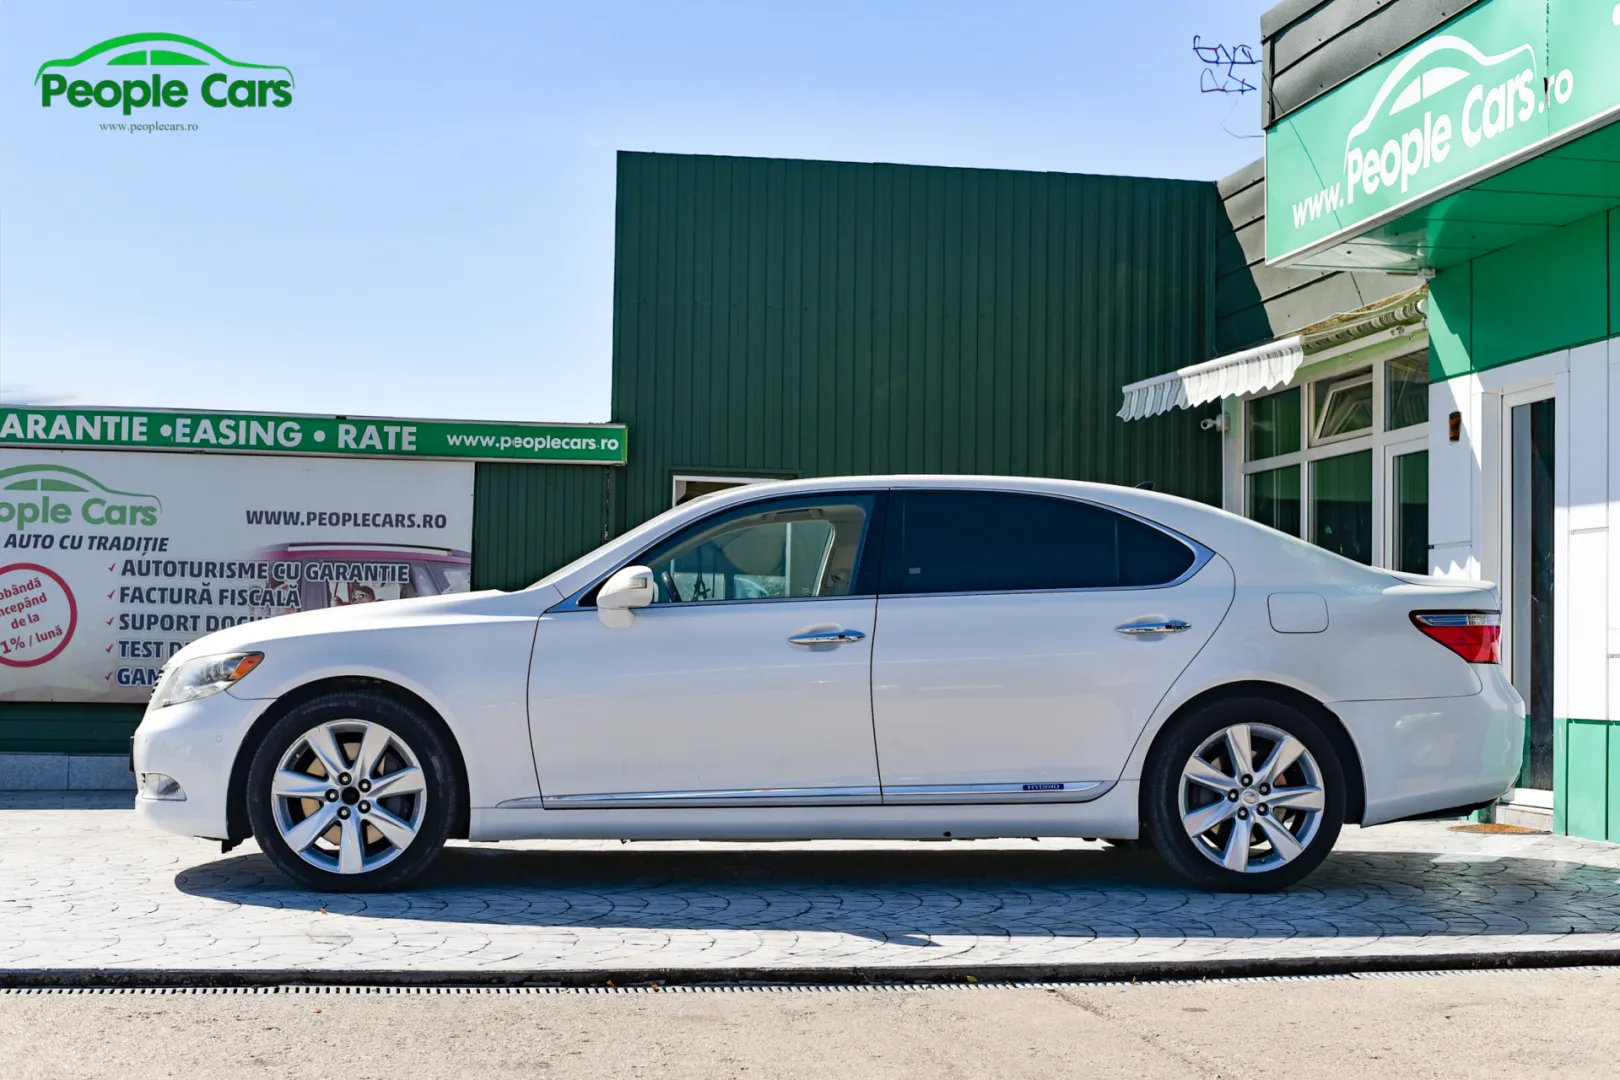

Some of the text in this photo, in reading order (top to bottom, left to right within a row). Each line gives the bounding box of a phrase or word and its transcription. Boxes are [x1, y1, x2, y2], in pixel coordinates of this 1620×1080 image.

[0, 413, 417, 450] ARANTIE EASING RATE
[447, 433, 619, 452] www.peoplecars.ro
[81, 498, 157, 527] Cars
[246, 510, 447, 529] WWW.PEOPLECARS.RO
[4, 533, 54, 549] AUTO
[59, 535, 83, 550] CU
[121, 559, 268, 580] AUTOTURISME
[273, 562, 300, 581] CU
[119, 582, 300, 607] FACTURĂ FISCALĂ
[11, 613, 40, 629] de la
[119, 613, 200, 632] SUPORT
[35, 625, 63, 643] lună
[119, 641, 164, 658] TEST
